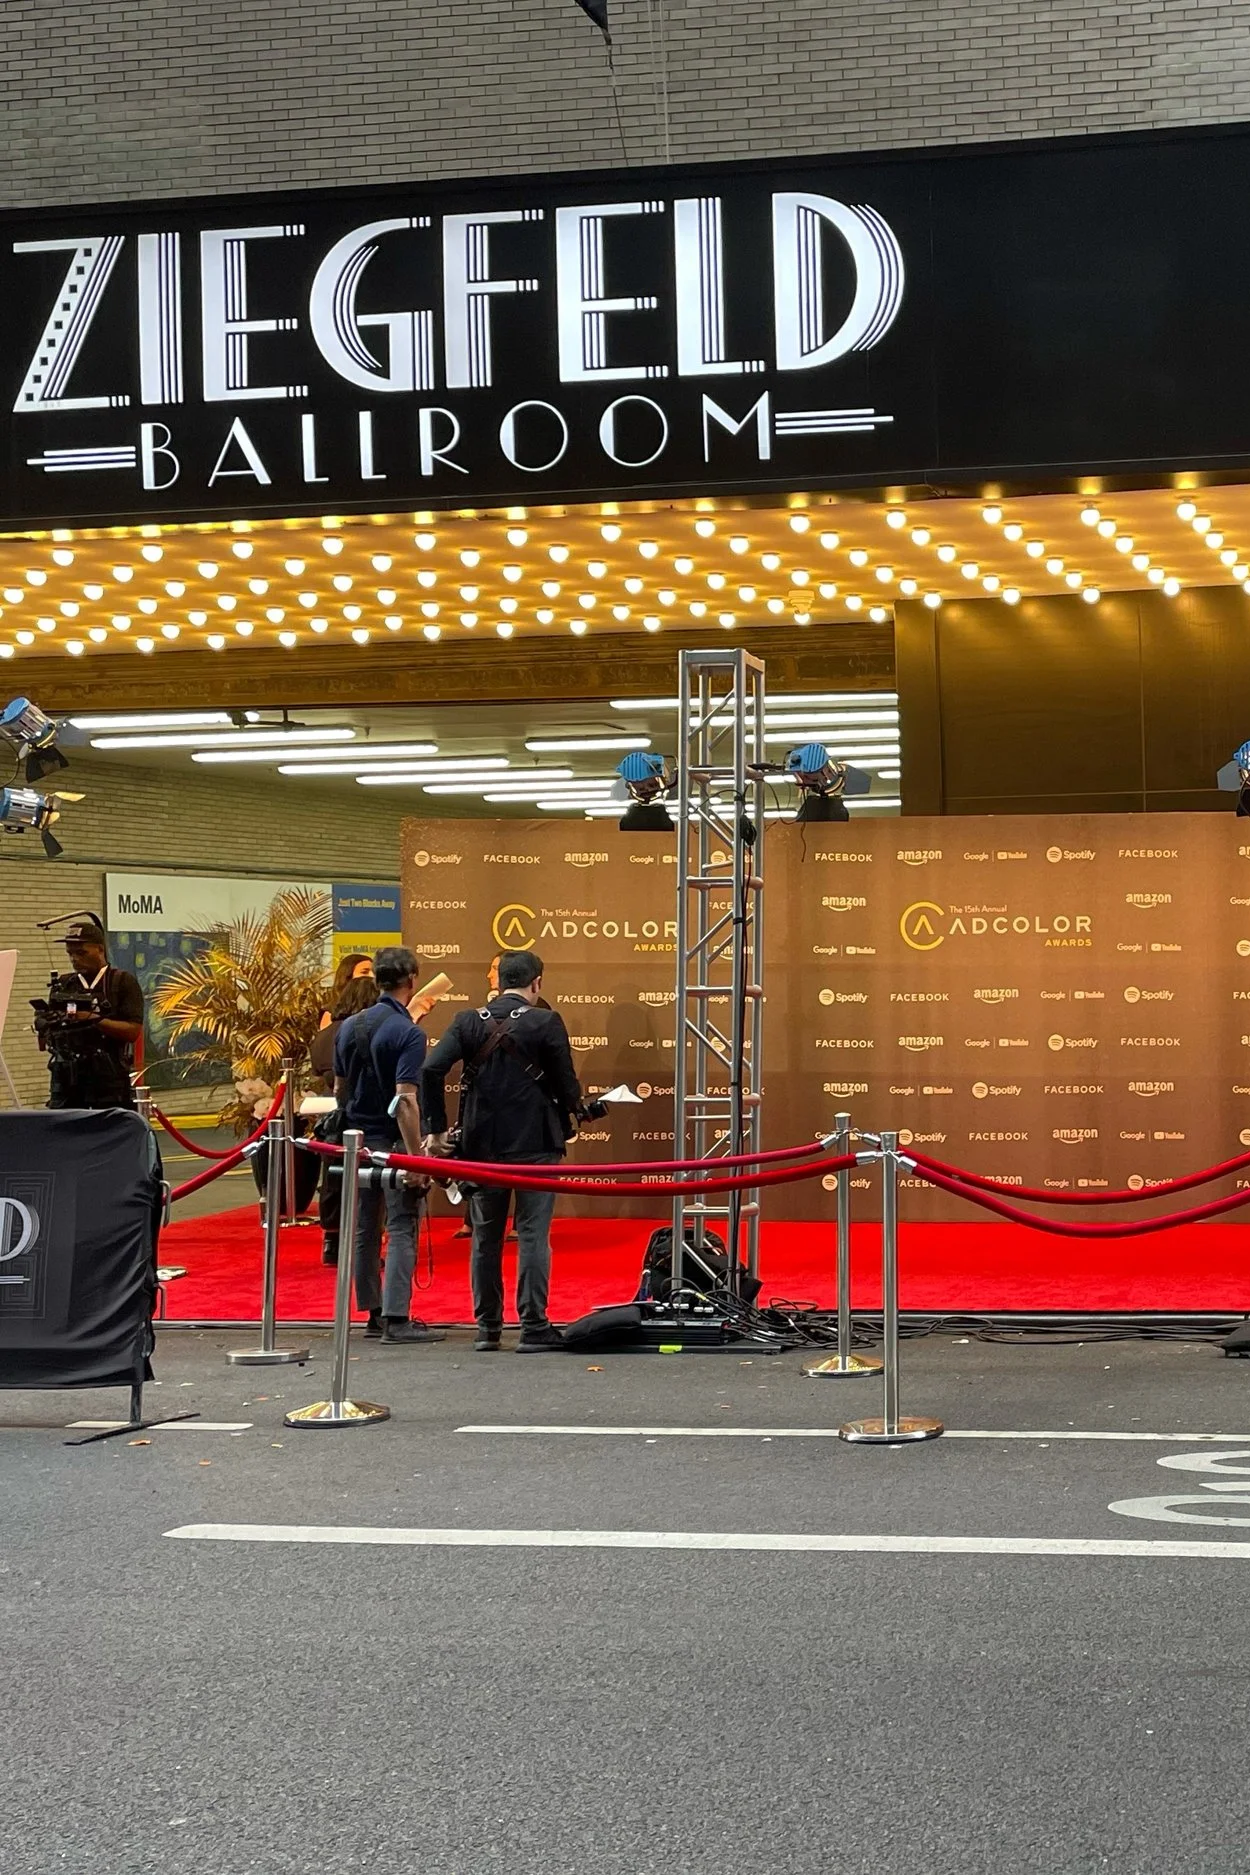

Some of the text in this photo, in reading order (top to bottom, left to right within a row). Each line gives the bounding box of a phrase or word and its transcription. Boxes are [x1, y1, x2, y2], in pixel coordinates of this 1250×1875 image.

[12, 191, 905, 412] ZIEGFELD
[140, 390, 771, 490] BALLROOM
[484, 855, 540, 863] FACEBOOK
[565, 852, 608, 864] amazon
[815, 853, 872, 862] FACEBOOK
[897, 850, 942, 862] amazon
[964, 853, 989, 861] Google
[1064, 850, 1096, 860] Spotify
[1119, 850, 1178, 858] FACEBOOK
[431, 854, 462, 865] Spotify
[630, 855, 654, 864] Google
[822, 896, 866, 907] amazon
[1126, 893, 1171, 904] amazon
[118, 895, 163, 914] MoMA
[410, 901, 467, 909] FACEBOOK
[950, 905, 1007, 913] The 15th Annual
[541, 922, 678, 937] ADCOLOR
[949, 916, 1091, 934] ADCOLOR
[416, 944, 460, 956] amazon
[813, 946, 837, 955] Google
[1117, 943, 1142, 952] Google
[638, 992, 676, 1002] amazo
[836, 993, 868, 1003] Spotify
[974, 988, 1019, 999] amazon
[1041, 991, 1065, 1000] Google
[1141, 990, 1174, 1000] Spotify
[708, 995, 729, 1003] oogle
[569, 1036, 608, 1046] mazon
[629, 1040, 653, 1048] Google
[816, 1040, 874, 1048] FACEBOOK
[899, 1036, 943, 1047] amazon
[965, 1039, 990, 1048] Google
[1065, 1038, 1097, 1048] Spotify
[1121, 1038, 1180, 1046] FACEBOOK
[654, 1086, 675, 1096] Spoti
[824, 1083, 868, 1093] amazon
[889, 1086, 914, 1095] Google
[990, 1085, 1021, 1096] Spotify
[1128, 1081, 1174, 1092] amazon
[580, 1131, 611, 1142] Spotify
[633, 1132, 690, 1141] FACEBOK
[915, 1132, 947, 1143] Spotify
[969, 1132, 1028, 1141] FACEBOOK
[1053, 1129, 1098, 1140] amazon
[1120, 1131, 1145, 1140] Google
[641, 1175, 673, 1184] amaz
[850, 1178, 871, 1189] otify
[1044, 1178, 1069, 1187] Google
